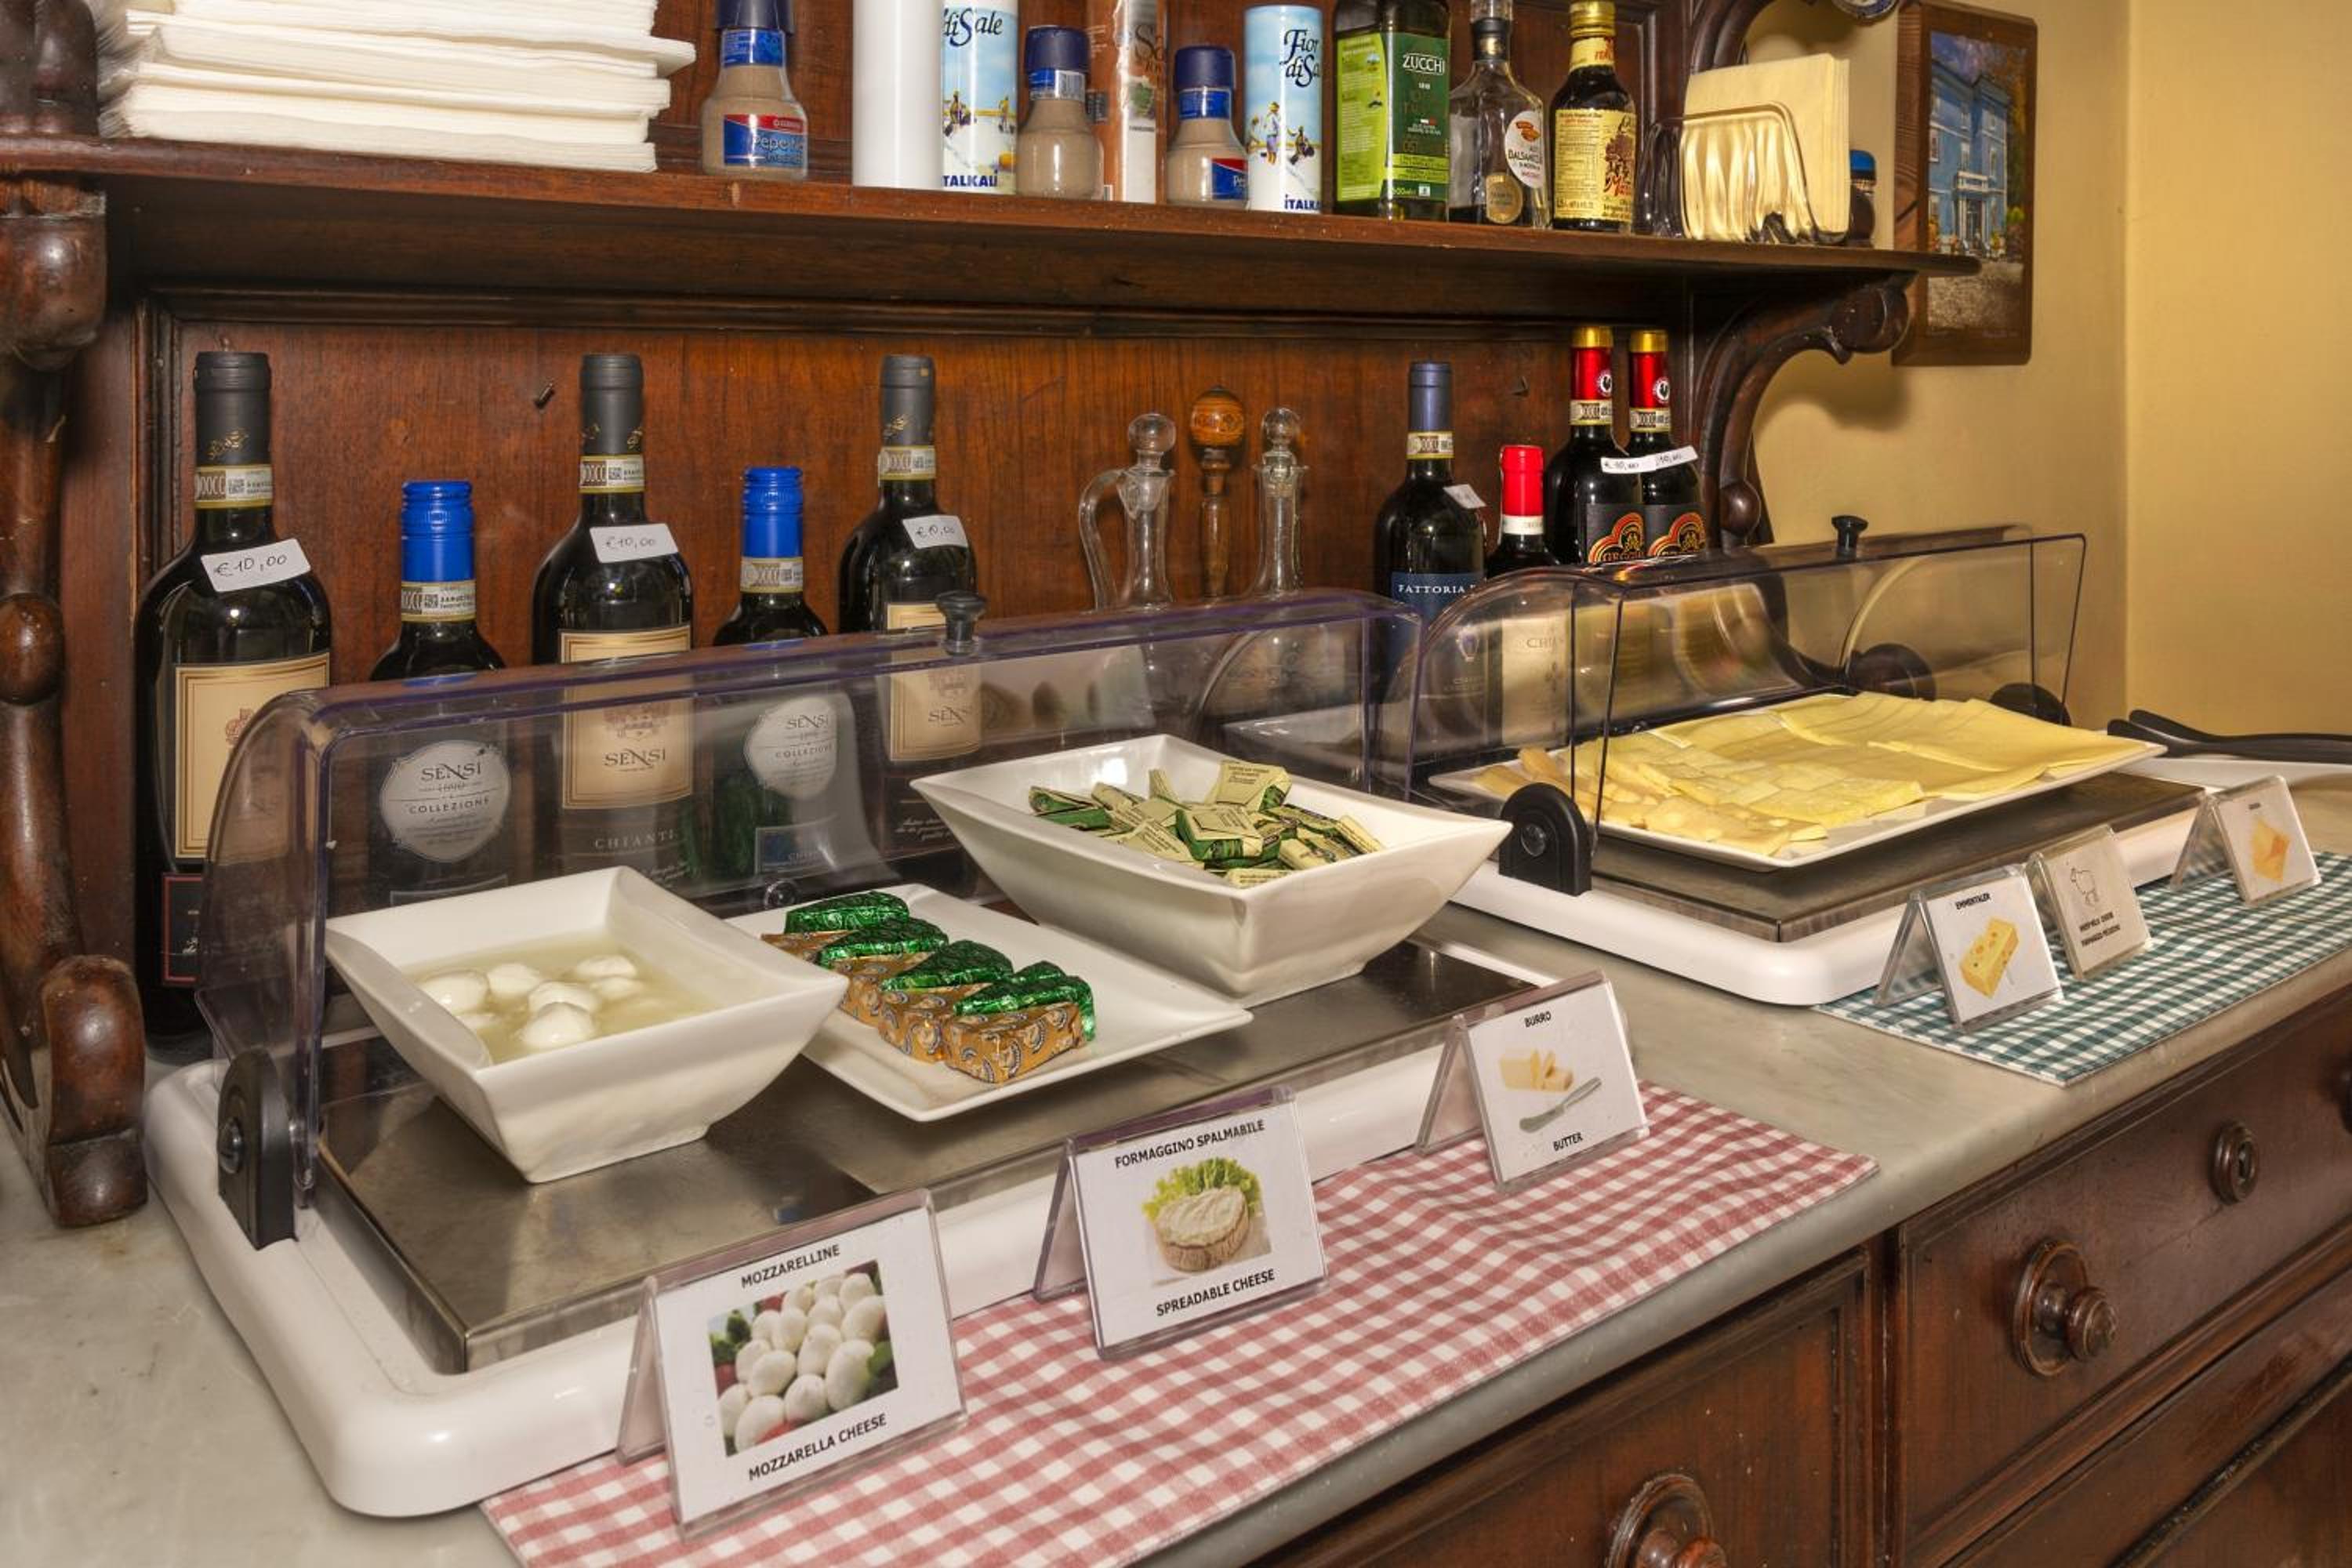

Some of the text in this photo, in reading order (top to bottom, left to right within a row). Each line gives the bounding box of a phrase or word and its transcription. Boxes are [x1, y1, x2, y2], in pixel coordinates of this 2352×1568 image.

[1280, 29, 1319, 65] Fior
[1403, 54, 1446, 74] ZUCCHI
[1398, 585, 1465, 594] FATTORIA
[786, 714, 829, 731] SENSI
[604, 747, 666, 768] SENSI
[420, 761, 482, 782] SENSI
[408, 796, 490, 815] COLLEZIONE
[594, 829, 676, 851] CHIANTI
[1524, 1011, 1552, 1028] BURRO
[1115, 1119, 1265, 1168] FORMAGGINO SPALMABILE
[1553, 1132, 1584, 1152] BUTTER
[741, 1243, 841, 1289] MOZZARELLINE
[1156, 1268, 1276, 1317] SPREADABLE CHEESE
[748, 1413, 887, 1482] MOZZARELLA CHEESE
